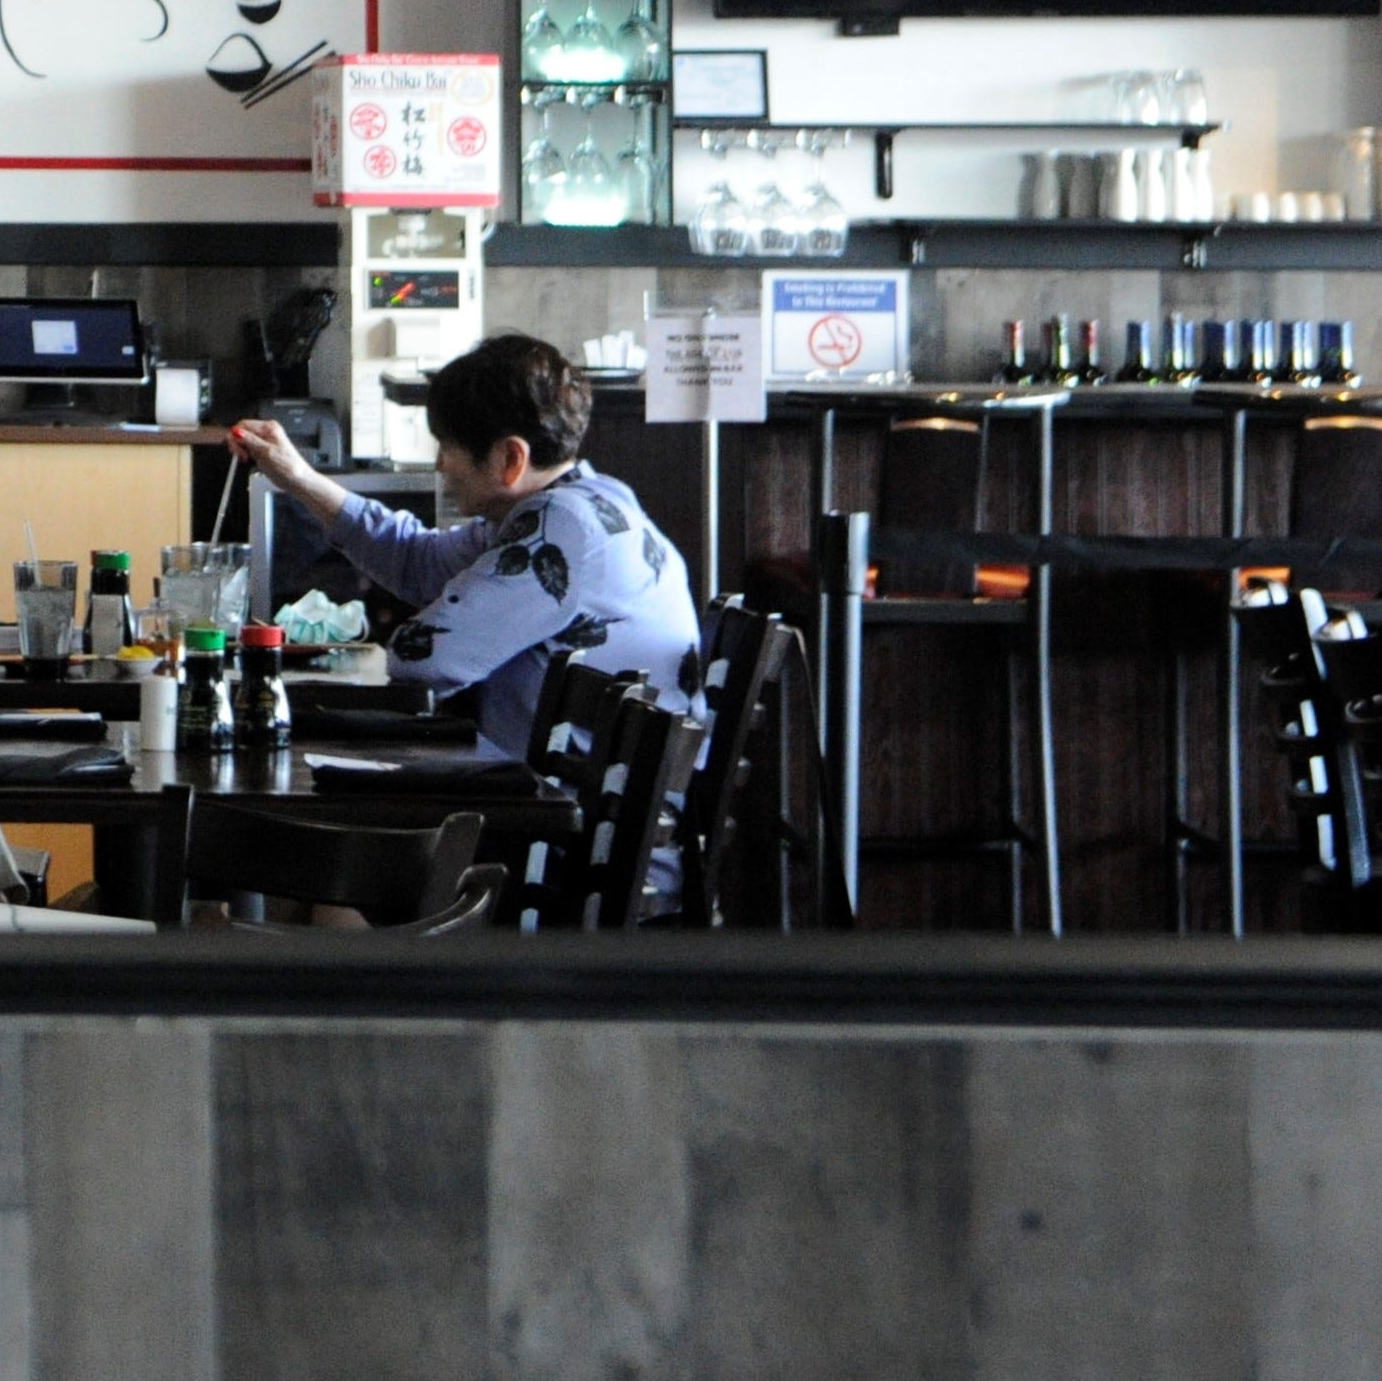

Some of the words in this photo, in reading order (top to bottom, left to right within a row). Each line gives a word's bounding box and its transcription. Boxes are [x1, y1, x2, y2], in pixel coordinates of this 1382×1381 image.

[349, 70, 376, 87] Sho
[380, 70, 421, 89] Chiku
[425, 70, 447, 89] Bai
